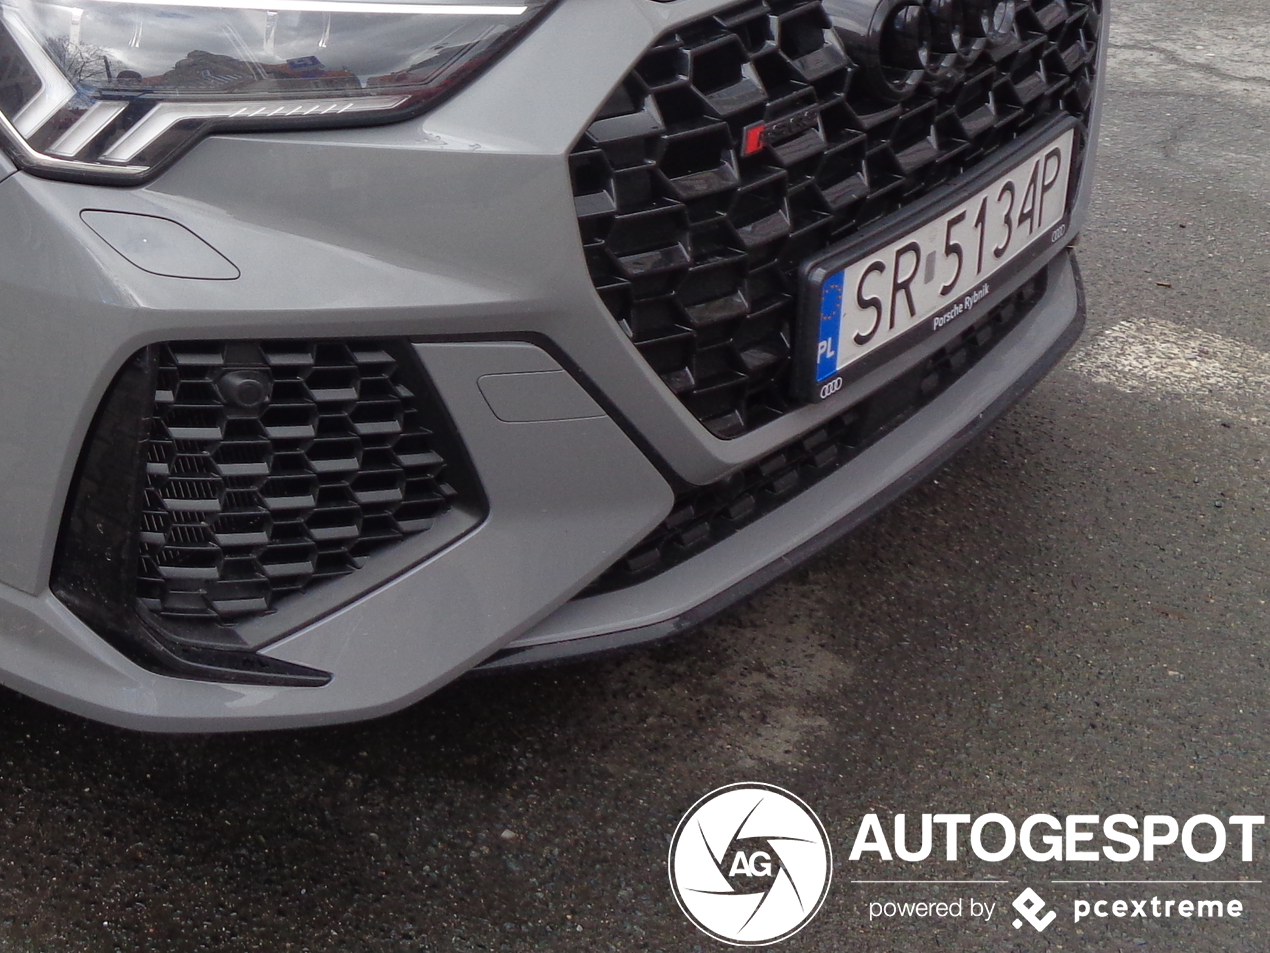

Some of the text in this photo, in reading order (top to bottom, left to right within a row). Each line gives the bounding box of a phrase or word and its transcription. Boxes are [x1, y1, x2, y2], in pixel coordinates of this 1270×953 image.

[852, 146, 1062, 347] SR 5134P
[933, 283, 990, 331] Porsche Rybnik
[817, 337, 835, 364] PL
